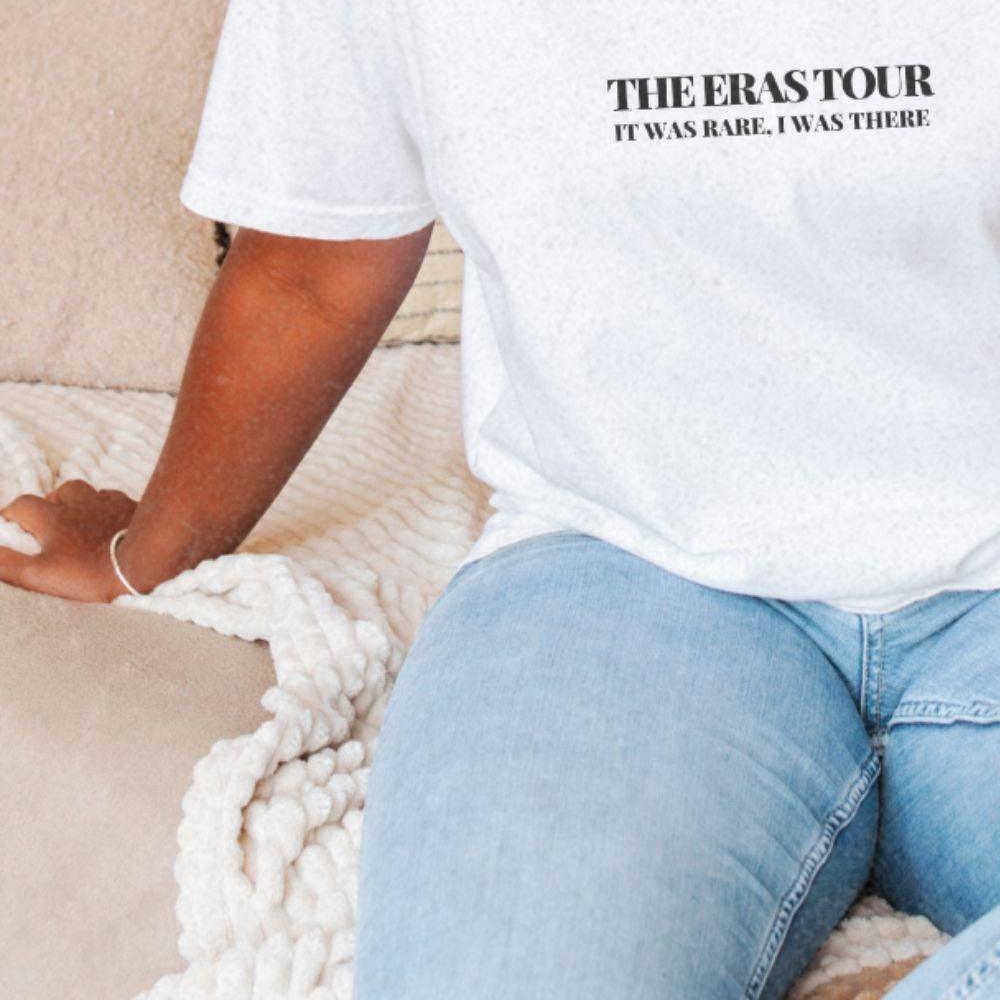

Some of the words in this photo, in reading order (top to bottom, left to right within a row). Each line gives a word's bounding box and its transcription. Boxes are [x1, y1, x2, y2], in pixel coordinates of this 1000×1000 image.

[606, 75, 696, 112] THE
[701, 70, 809, 107] ERAS
[812, 64, 936, 102] TOUR
[614, 123, 639, 142] IT
[643, 120, 697, 140] WAS
[776, 115, 786, 134] I
[790, 112, 844, 133] WAS
[848, 108, 931, 131] THERE
